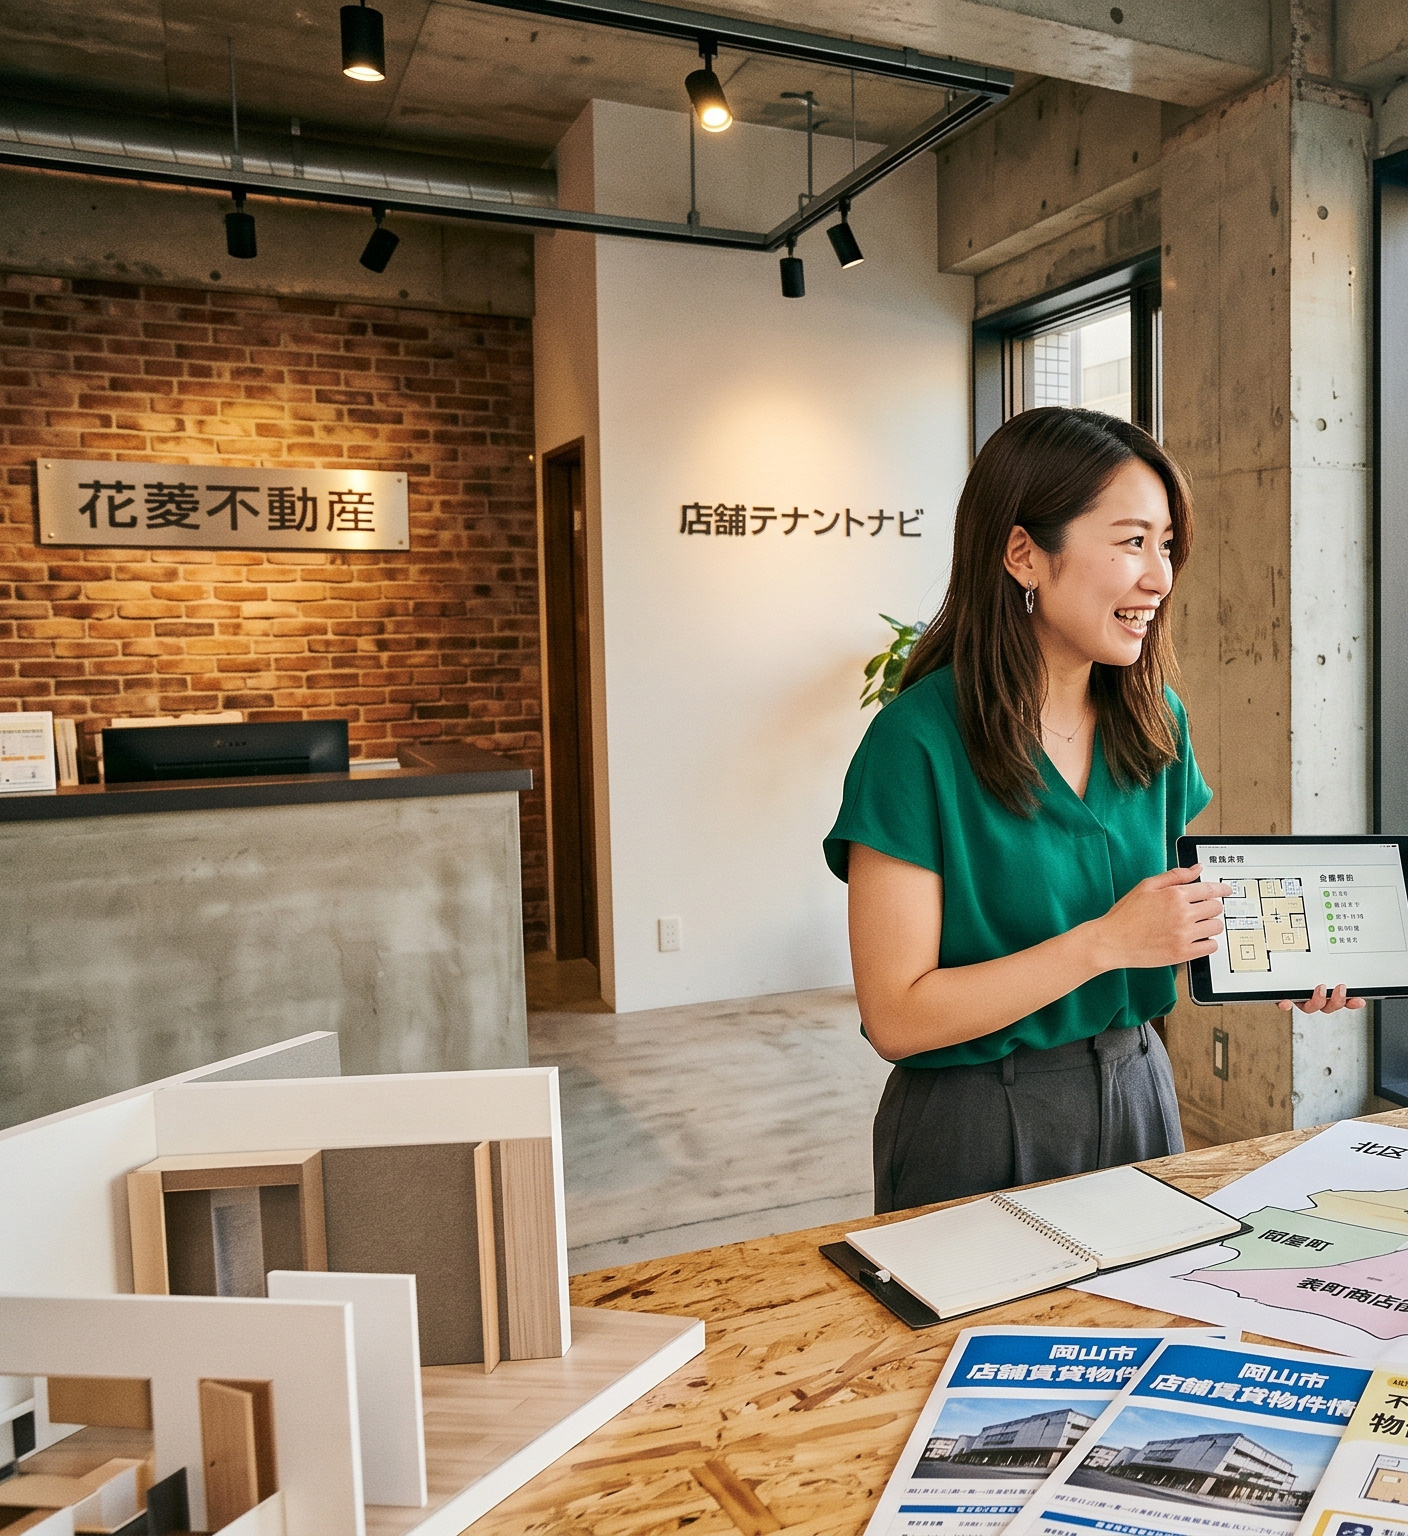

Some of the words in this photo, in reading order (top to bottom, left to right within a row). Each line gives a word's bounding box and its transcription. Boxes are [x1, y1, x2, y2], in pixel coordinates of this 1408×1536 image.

[78, 480, 376, 532] 花菱不動産
[679, 501, 925, 538] 店舗テナントナビ
[1048, 1344, 1138, 1362] 岡山市
[1237, 1362, 1330, 1389] 岡山市
